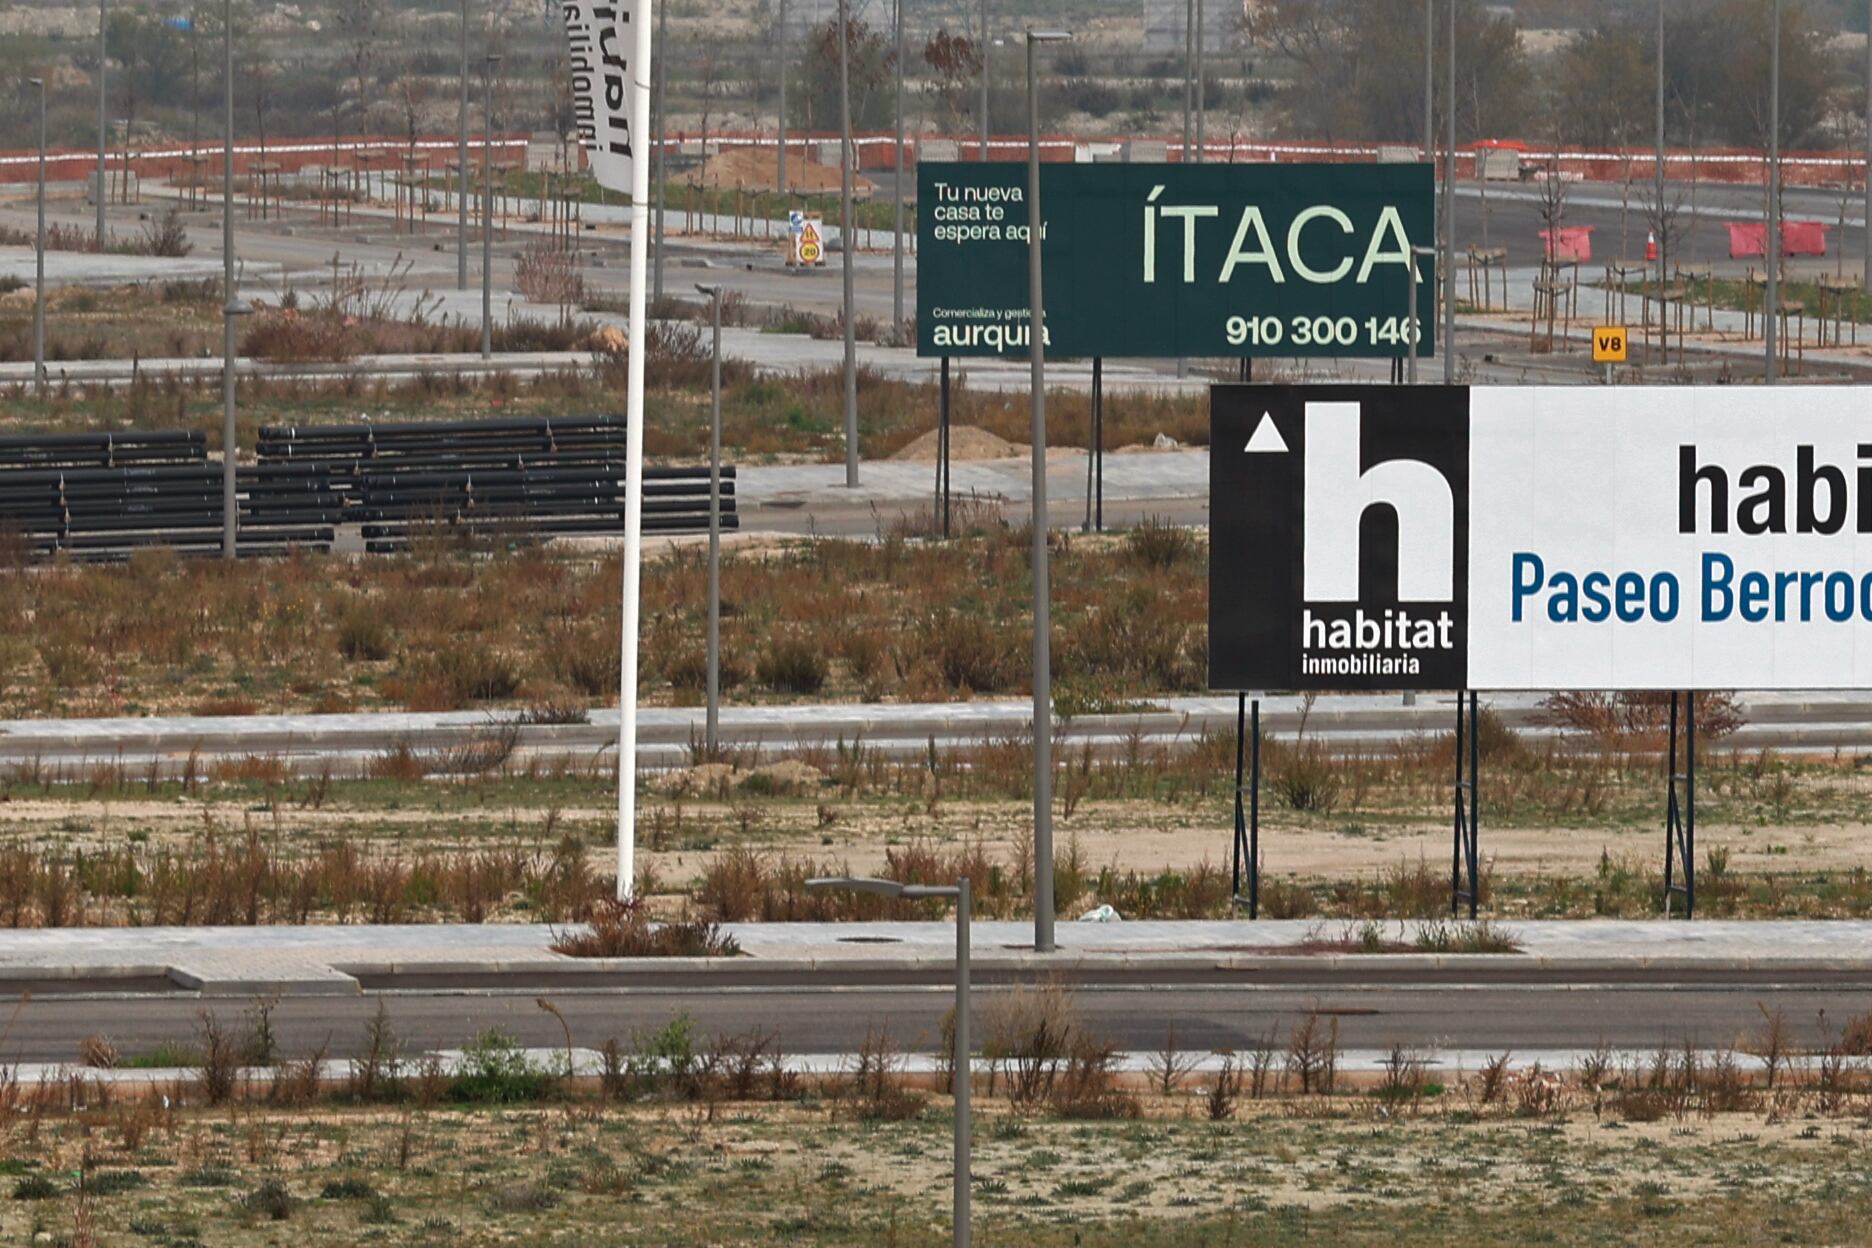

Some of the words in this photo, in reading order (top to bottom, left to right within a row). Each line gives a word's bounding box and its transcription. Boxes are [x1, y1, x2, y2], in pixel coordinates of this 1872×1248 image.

[934, 182, 959, 202] Tu
[964, 186, 1024, 202] nueva
[934, 205, 981, 221] casa
[985, 203, 1005, 221] te
[934, 224, 1002, 245] espera
[1005, 221, 1048, 245] aqí
[1143, 184, 1423, 284] ÍTACA
[933, 307, 996, 319] Comercializa
[995, 309, 1002, 321] y
[1225, 315, 1284, 345] 910
[1291, 315, 1358, 345] 300
[1364, 315, 1422, 345] 146
[1598, 336, 1622, 352] V8
[1511, 551, 1680, 623] Paseo
[1302, 609, 1454, 649] habitat
[1302, 653, 1420, 675] inmobiliaria
